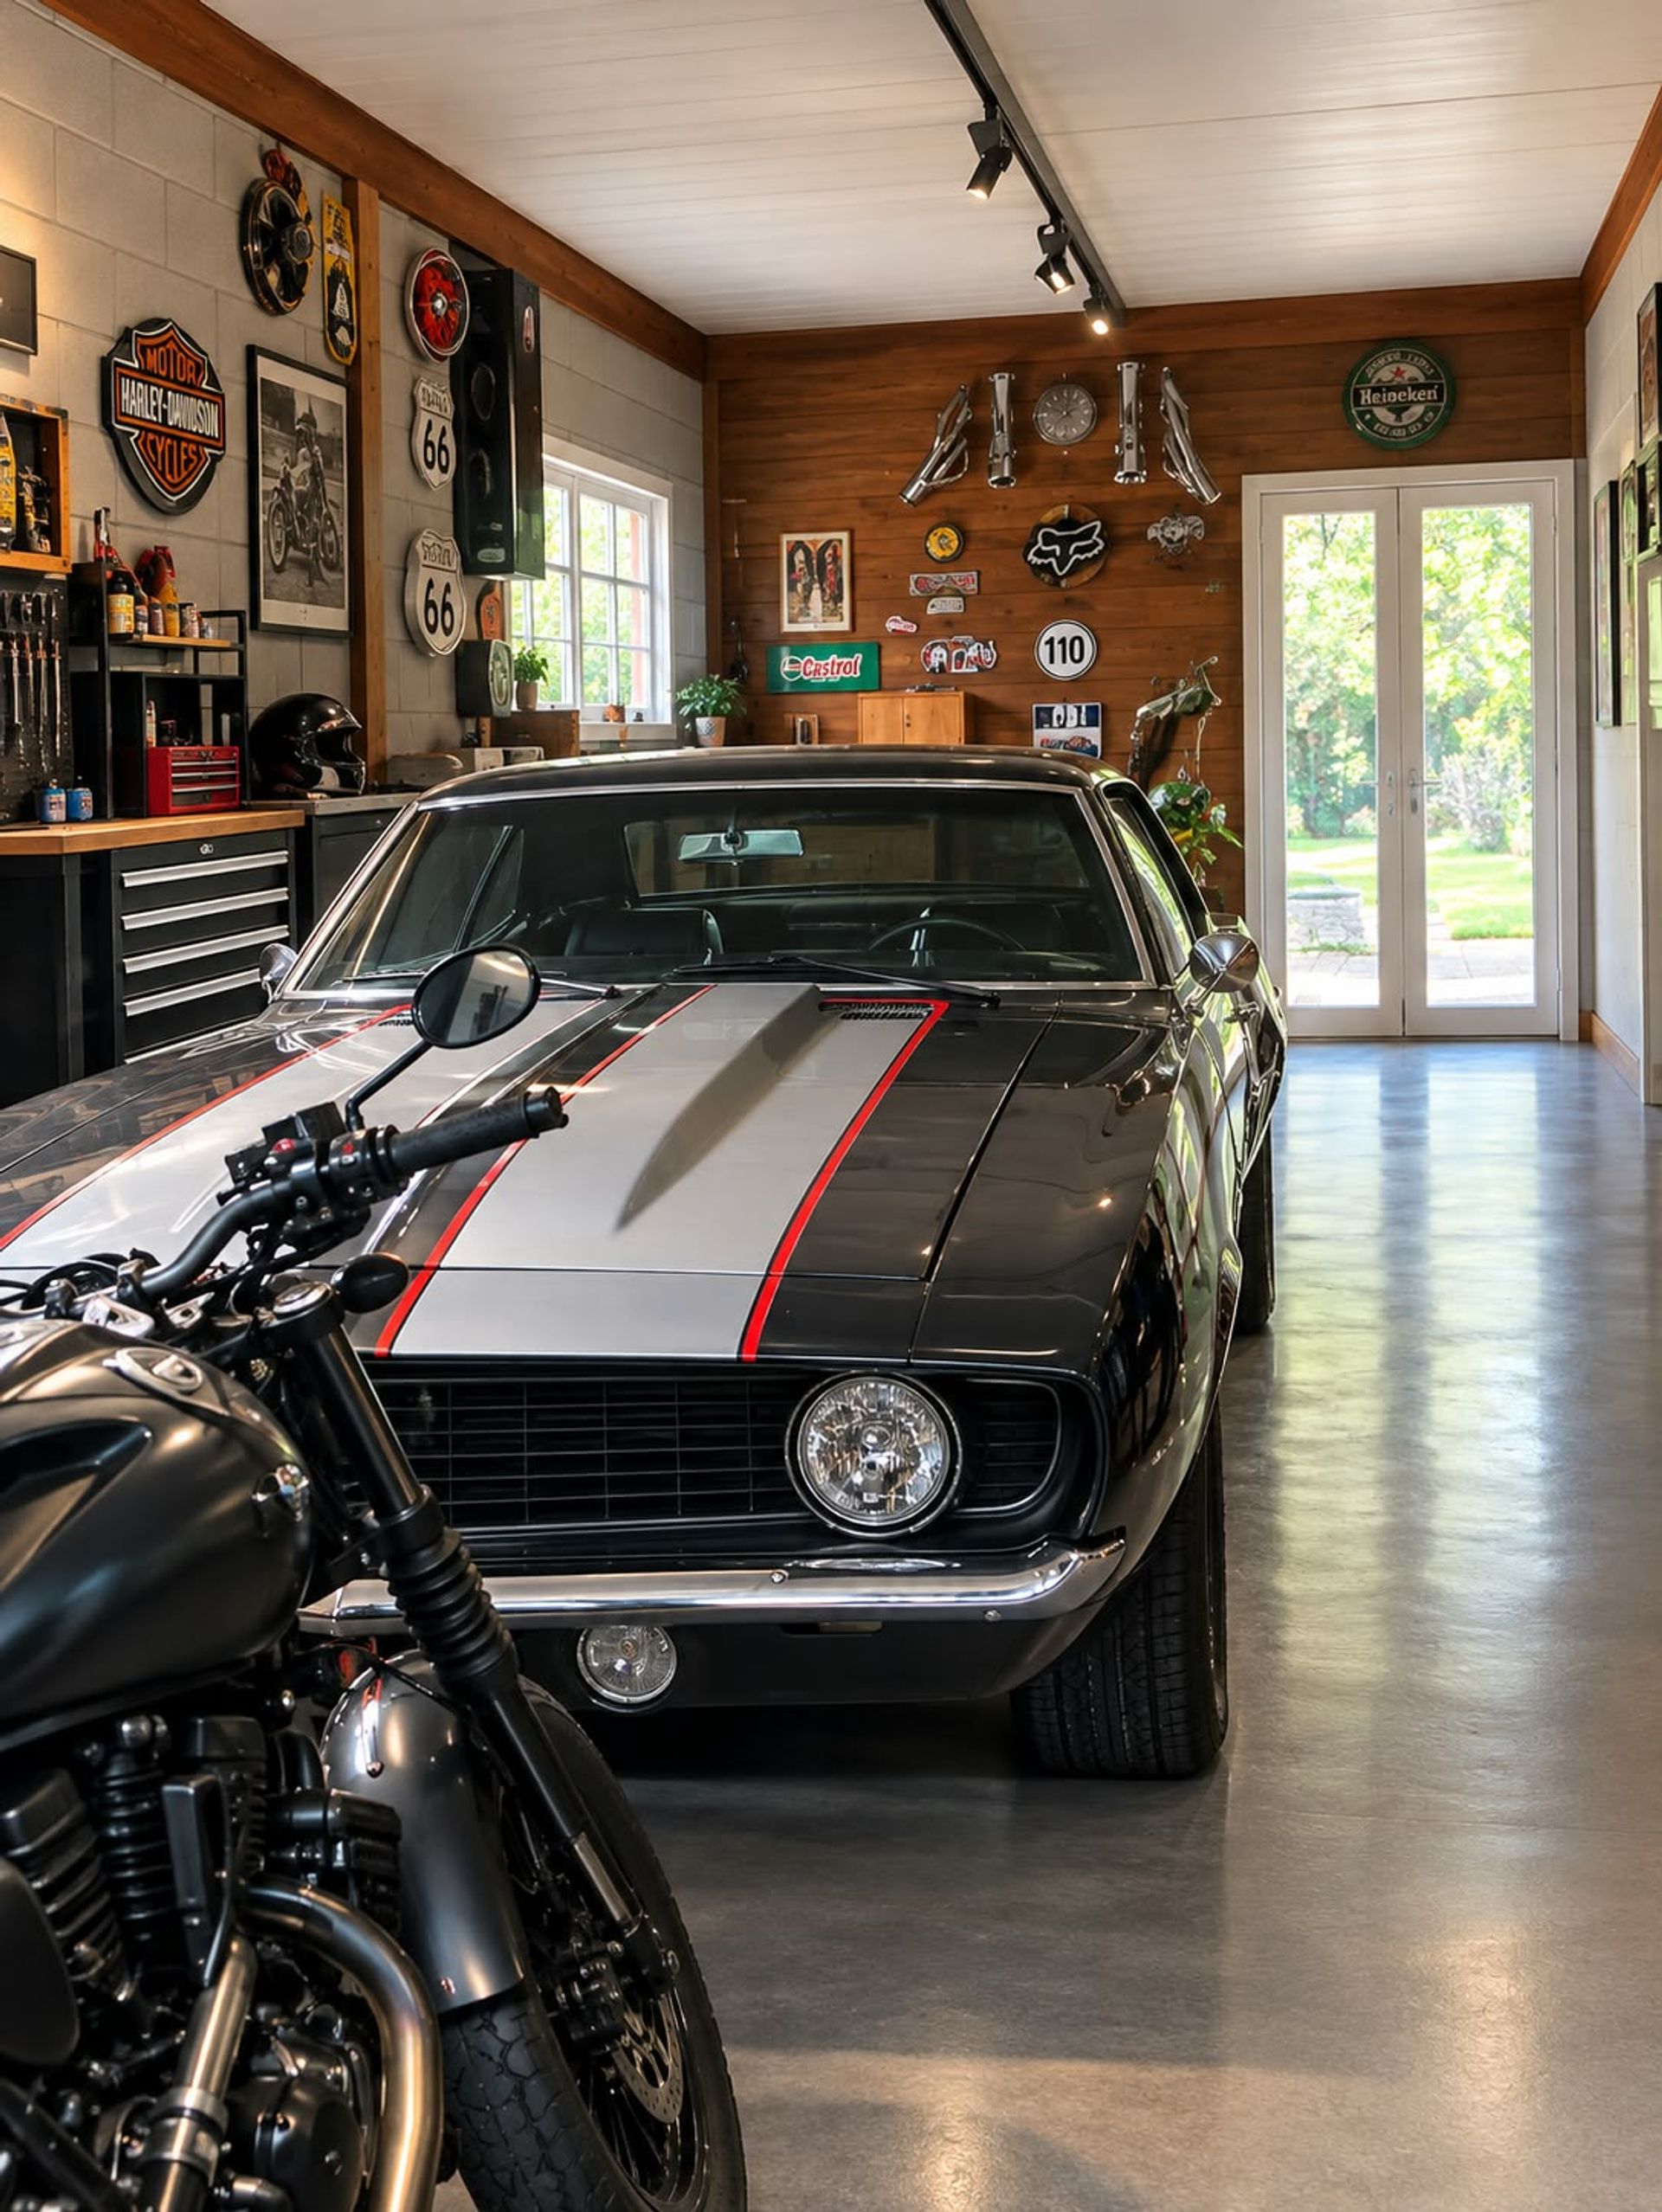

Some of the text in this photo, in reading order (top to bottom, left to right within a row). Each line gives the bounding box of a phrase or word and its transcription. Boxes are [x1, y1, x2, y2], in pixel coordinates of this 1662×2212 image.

[145, 342, 196, 386] MOTOR
[146, 434, 198, 484] CYCLES
[423, 419, 450, 475] 66
[424, 577, 454, 637] 66
[1044, 635, 1085, 666] 110
